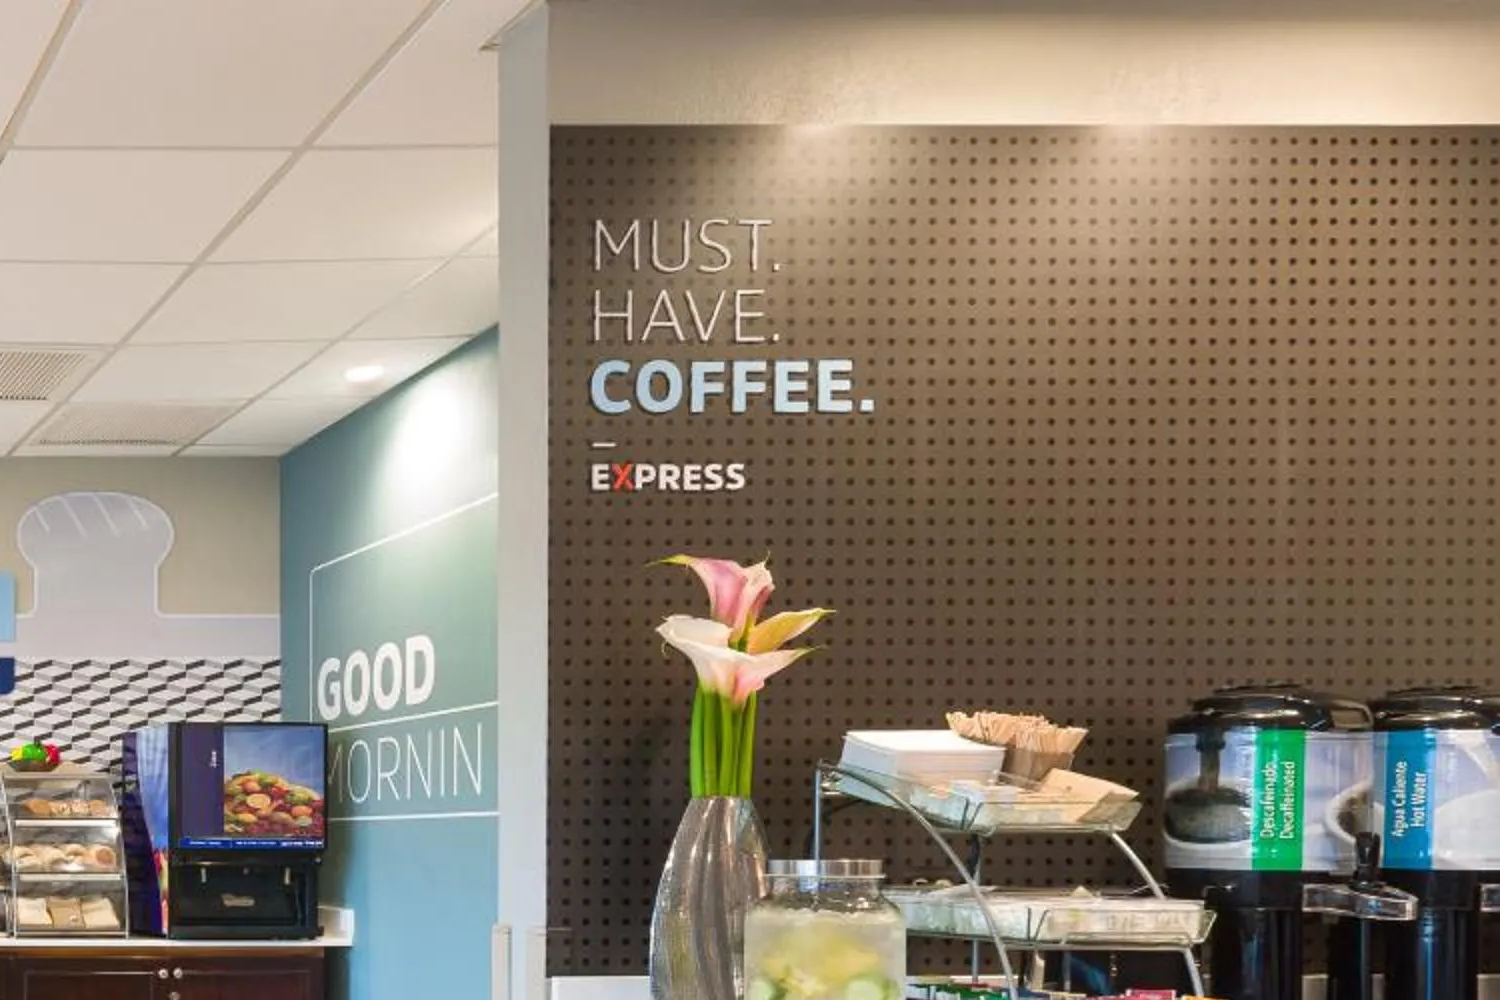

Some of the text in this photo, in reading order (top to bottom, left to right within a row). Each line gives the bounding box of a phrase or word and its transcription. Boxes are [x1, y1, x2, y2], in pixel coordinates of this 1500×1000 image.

[593, 218, 781, 273] MUST.
[593, 288, 781, 342] HAVE.
[590, 359, 875, 414] COFFEE.
[591, 462, 747, 491] EXPRESS
[317, 634, 436, 721] GOOD
